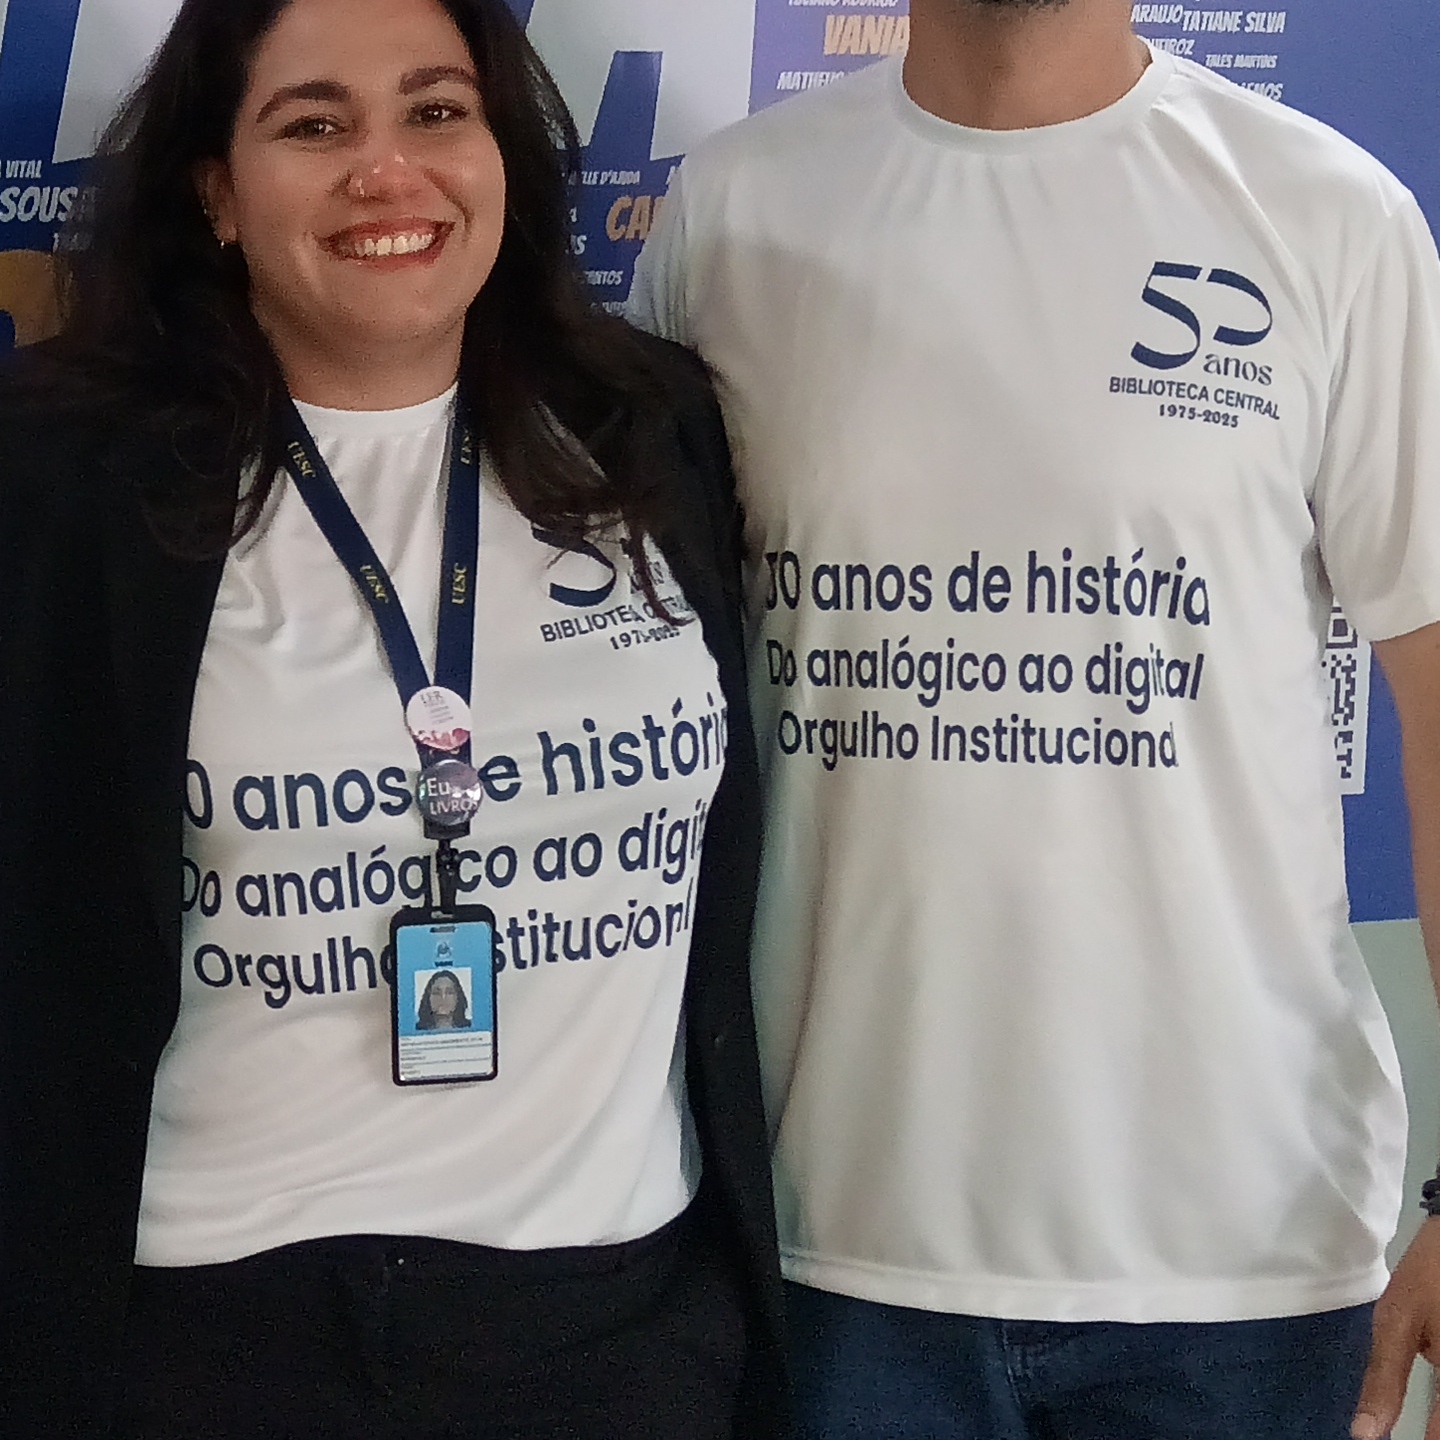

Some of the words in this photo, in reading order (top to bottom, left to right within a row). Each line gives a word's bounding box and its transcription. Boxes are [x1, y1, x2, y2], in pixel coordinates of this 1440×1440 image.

[1131, 261, 1273, 371] 50
[1109, 376, 1209, 402] BIBLIOTECA
[1213, 388, 1280, 420] CENTRAL
[1203, 353, 1273, 386] anos
[1159, 404, 1239, 428] 1975-2025
[812, 562, 932, 613] anos
[947, 550, 1012, 613] de
[1027, 546, 1211, 626] história
[766, 639, 797, 687] Do
[806, 634, 1007, 708] analógico
[1019, 653, 1074, 694] ao
[1084, 641, 1205, 715] digital
[778, 710, 919, 771] Orgulho
[183, 759, 214, 829] 0
[233, 766, 413, 831] anos
[477, 756, 522, 802] e
[236, 844, 518, 917] analógco
[533, 833, 603, 882] ao
